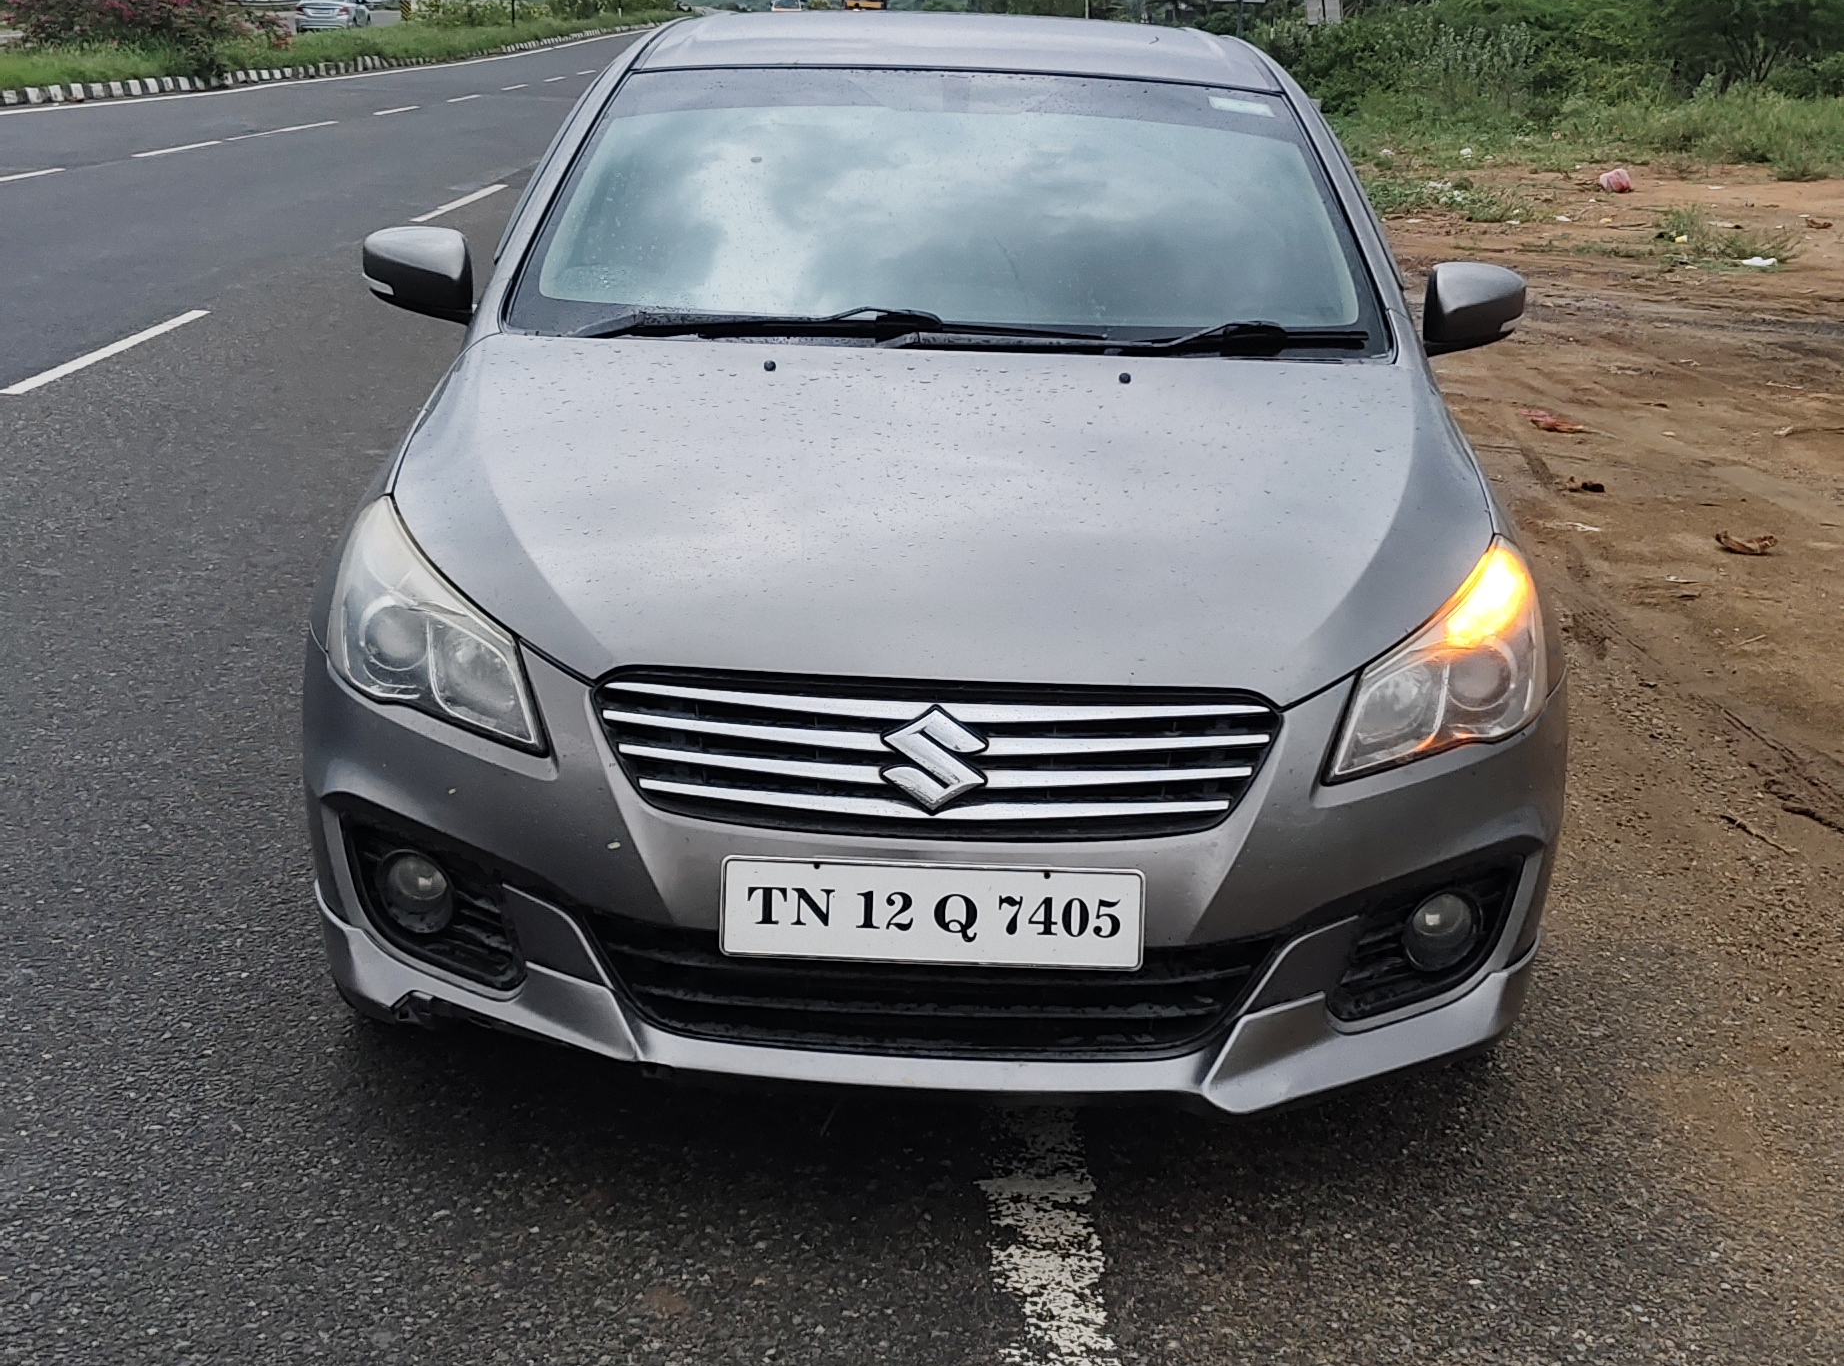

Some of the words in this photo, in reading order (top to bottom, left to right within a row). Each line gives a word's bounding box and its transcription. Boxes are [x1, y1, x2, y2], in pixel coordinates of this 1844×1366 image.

[747, 886, 836, 927] TN
[855, 890, 914, 932] 12
[933, 893, 978, 943] Q
[998, 895, 1122, 939] 7405
